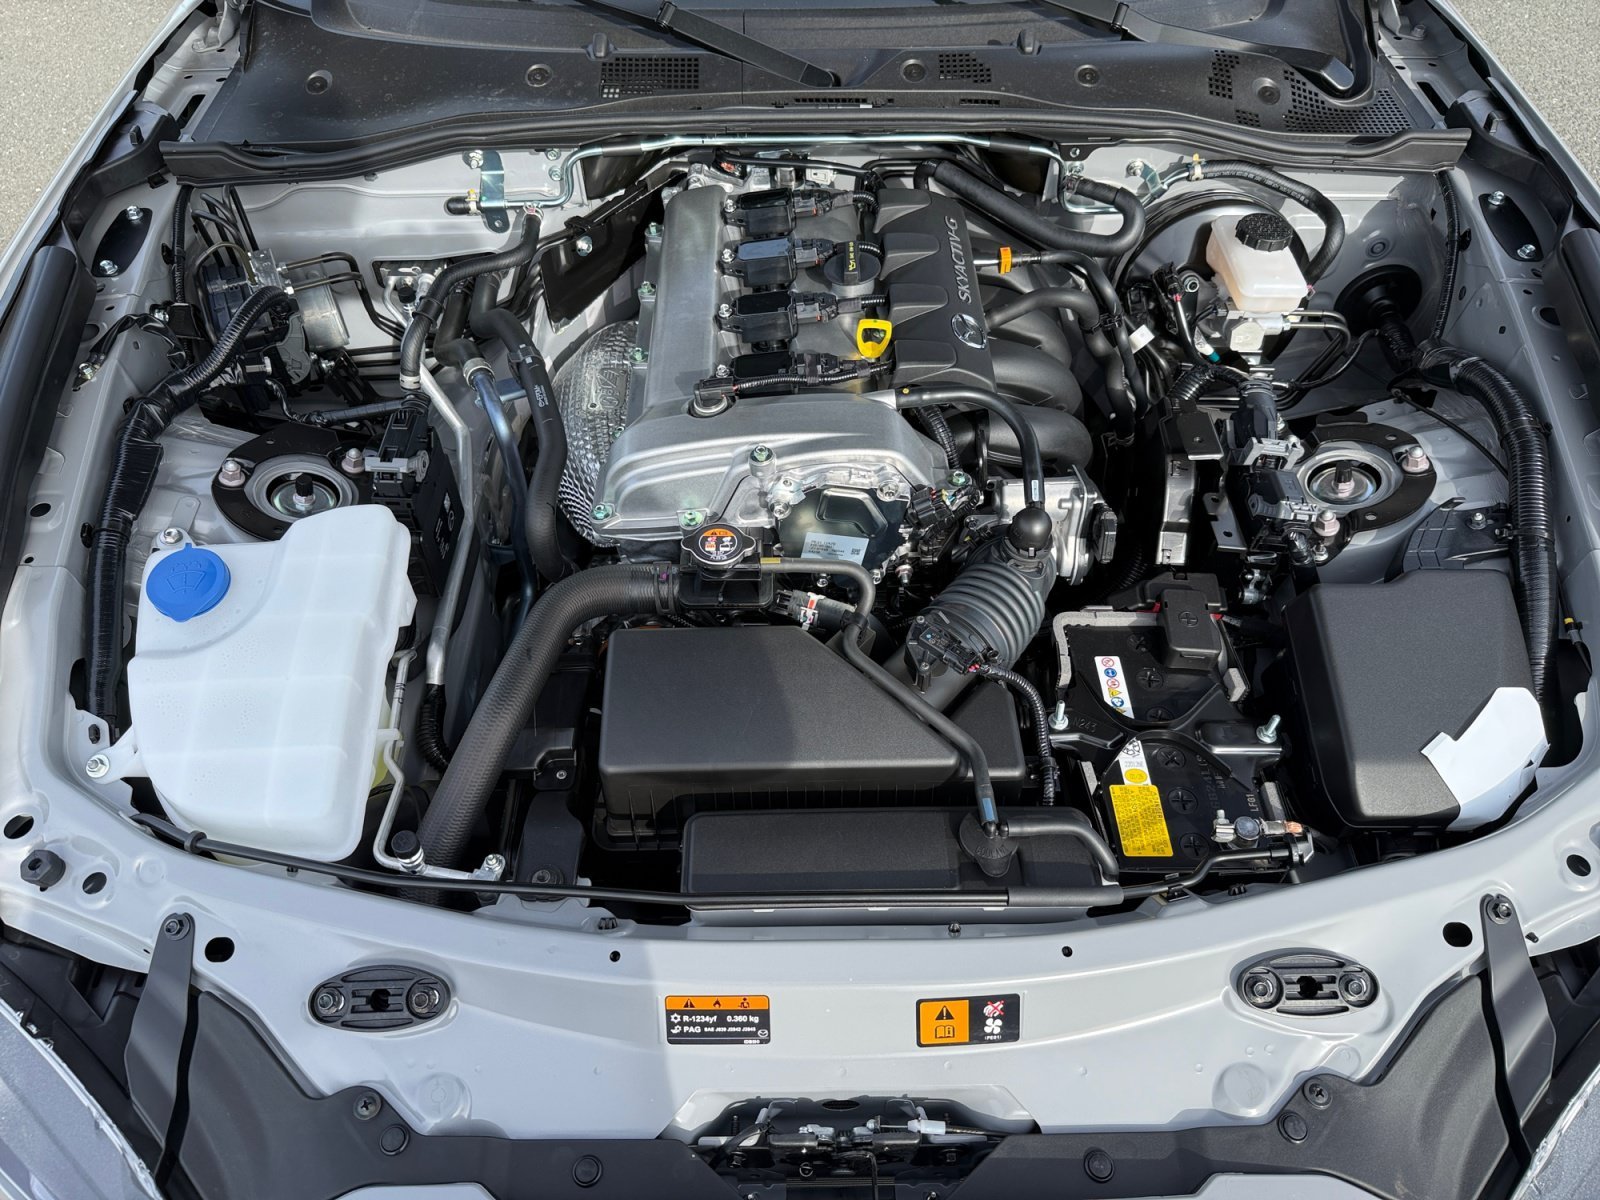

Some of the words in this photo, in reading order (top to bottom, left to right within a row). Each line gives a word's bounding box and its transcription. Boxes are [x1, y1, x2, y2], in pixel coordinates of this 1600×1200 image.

[944, 215, 972, 305] SKYACTIV-G
[683, 1015, 717, 1023] R-1234yf
[749, 1015, 759, 1023] kg
